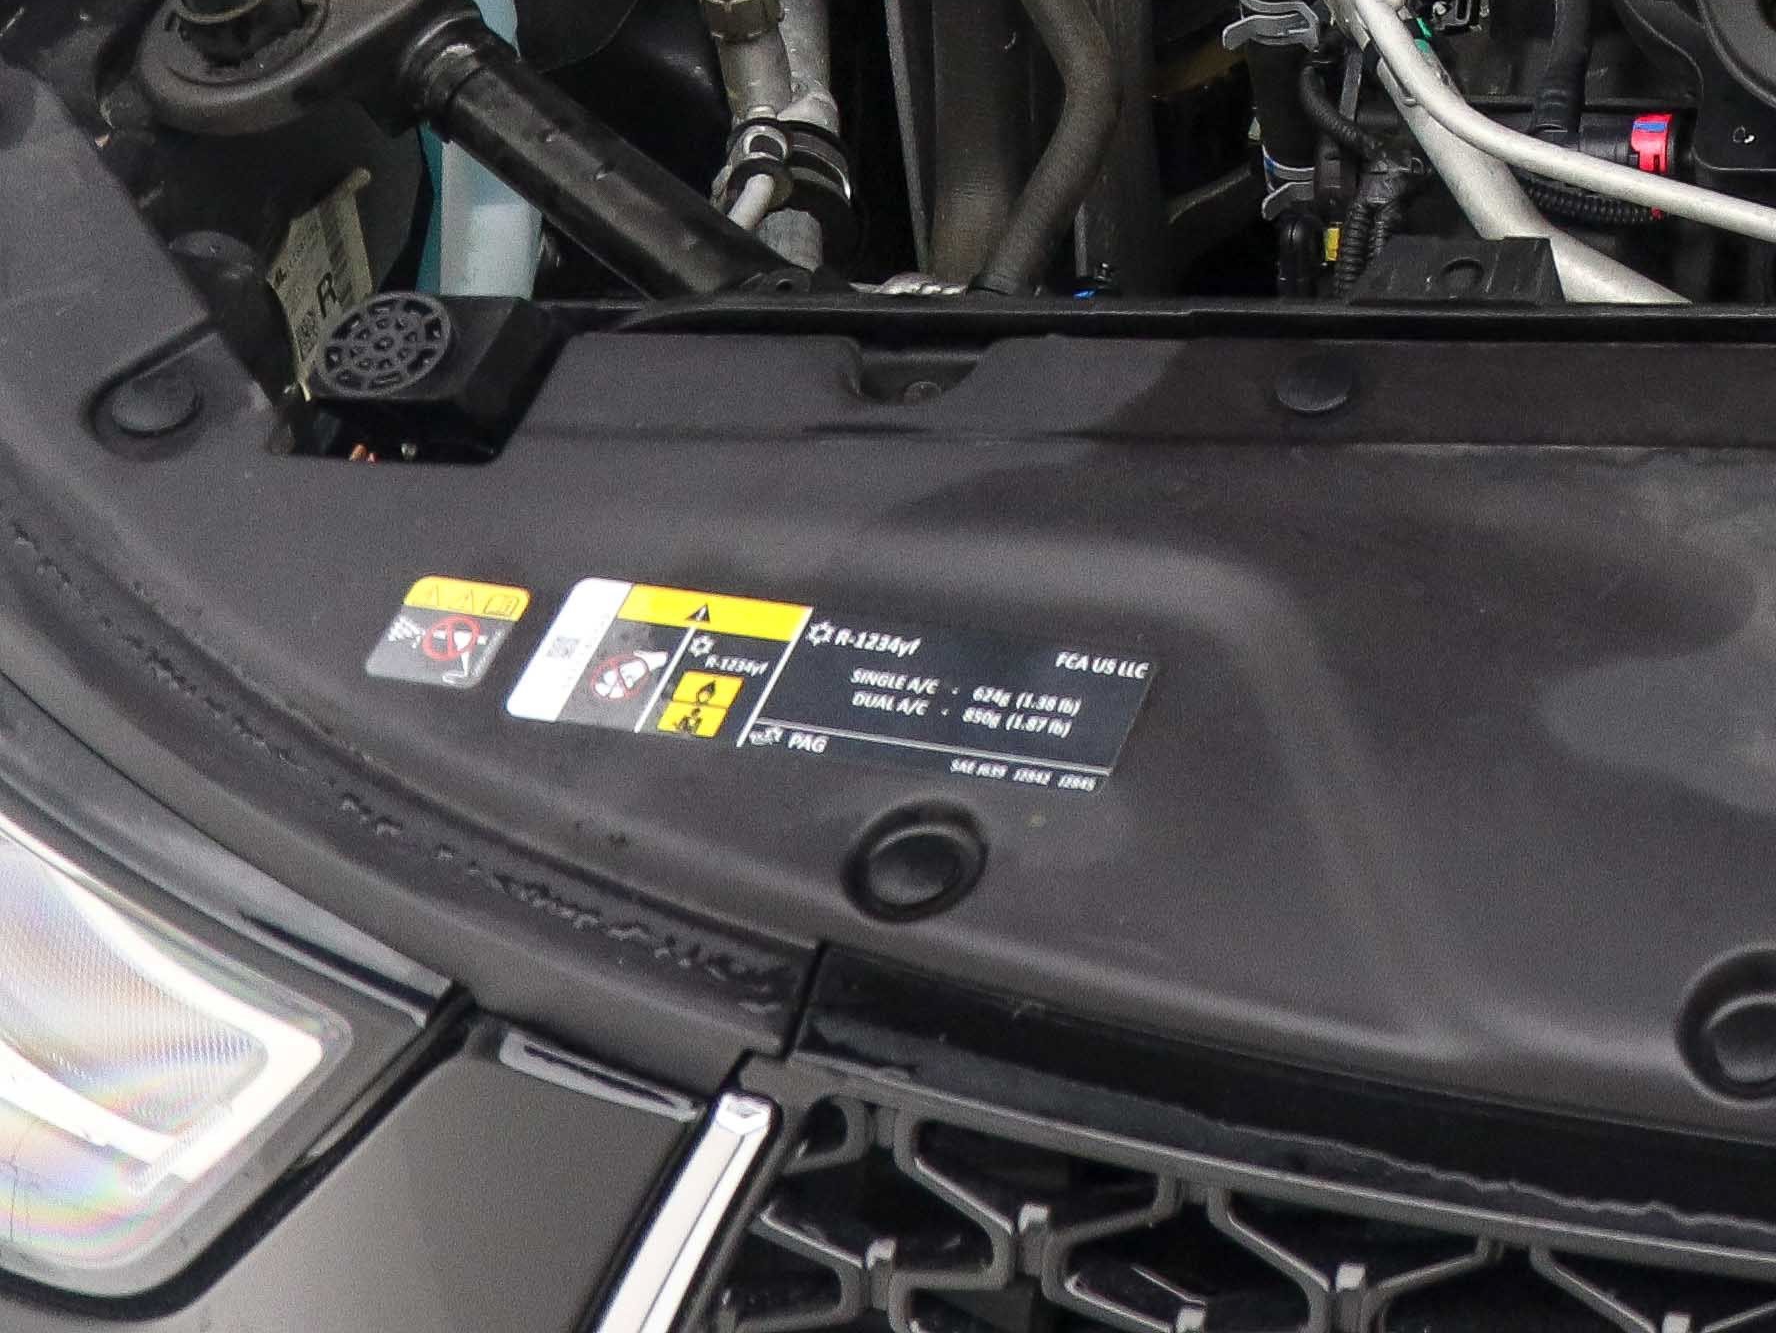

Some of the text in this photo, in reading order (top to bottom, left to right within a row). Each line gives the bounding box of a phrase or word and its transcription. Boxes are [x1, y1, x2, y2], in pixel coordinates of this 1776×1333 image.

[835, 628, 921, 658] R-1234yf
[1055, 651, 1150, 679] FCA US LLC
[851, 668, 906, 691] SINGLE
[904, 676, 940, 695] A/C
[852, 690, 894, 712] DUAL
[895, 698, 930, 717] A/C
[787, 731, 828, 754] PAG
